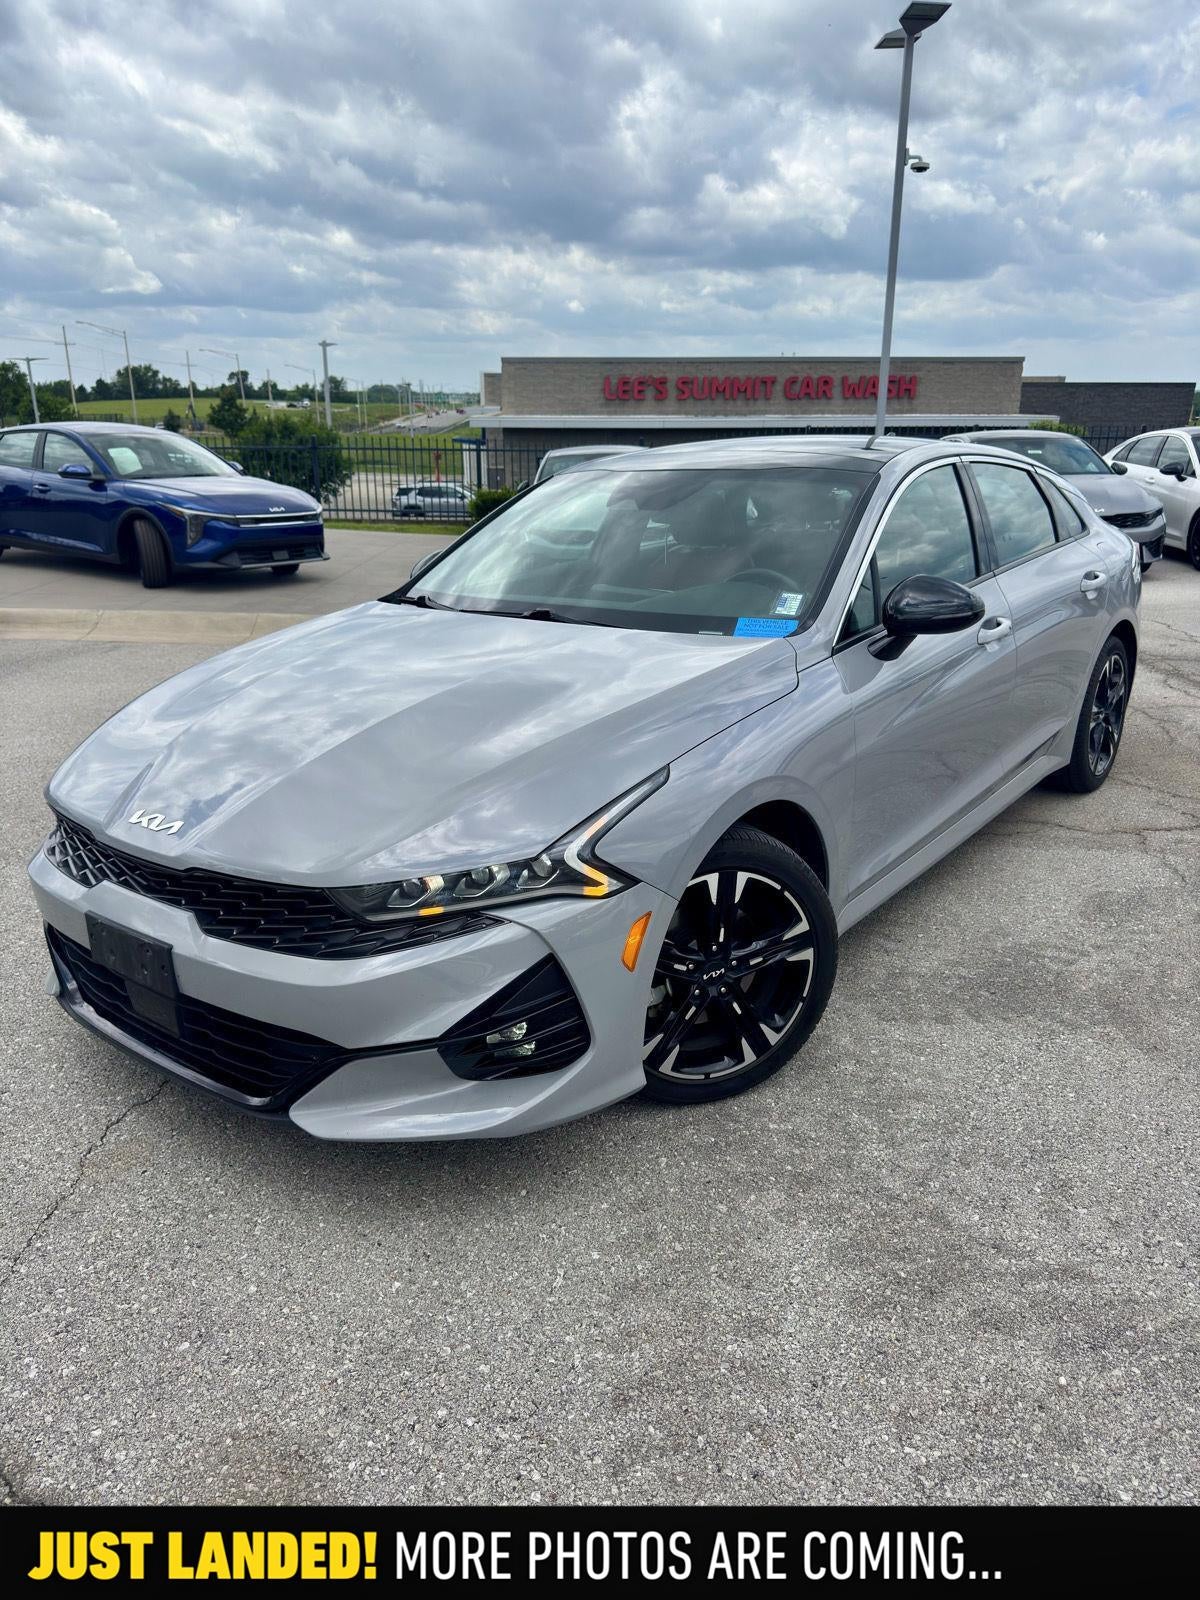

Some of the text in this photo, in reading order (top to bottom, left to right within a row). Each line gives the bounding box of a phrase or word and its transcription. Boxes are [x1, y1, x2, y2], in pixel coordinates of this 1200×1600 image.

[603, 376, 669, 400] LEE'S
[675, 376, 776, 400] SUMMIT
[784, 376, 834, 399] CAR
[128, 809, 184, 835] KIA
